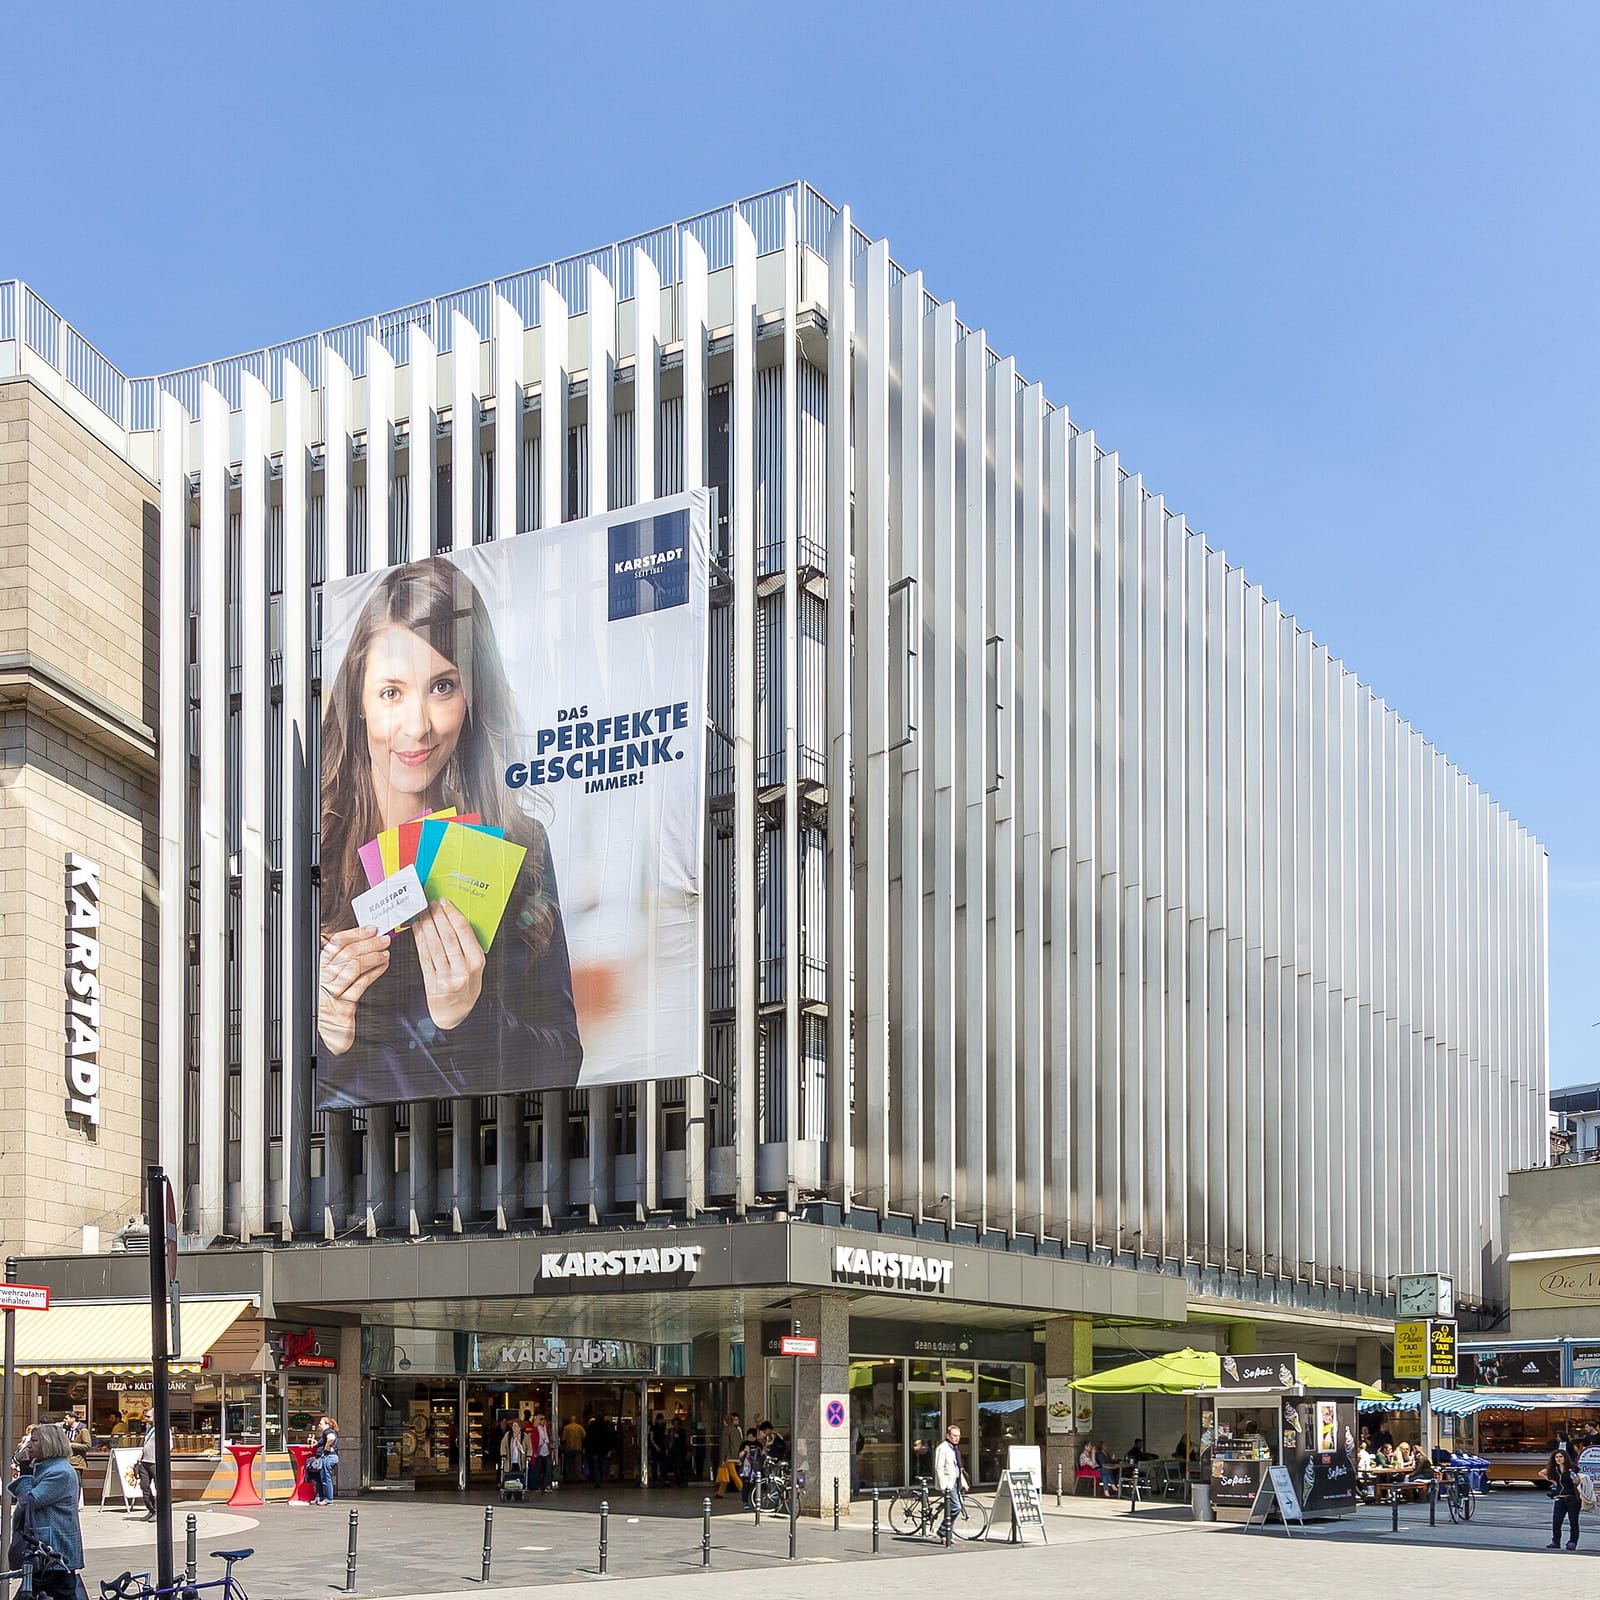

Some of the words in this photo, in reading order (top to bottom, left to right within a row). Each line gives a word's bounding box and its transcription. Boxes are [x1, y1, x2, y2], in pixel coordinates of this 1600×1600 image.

[614, 547, 683, 574] KARSTADT
[633, 568, 649, 579] SEIT
[557, 705, 588, 722] DAS
[537, 701, 688, 755] PERFEKTE
[505, 735, 684, 789] GESCHENK.
[585, 772, 644, 794] IMMER!
[369, 885, 407, 912] KARSTADT
[65, 851, 100, 1125] KARSTADT
[541, 1246, 702, 1278] KARSTADT
[835, 1246, 953, 1284] KARSTADT
[1548, 1275, 1575, 1288] Die
[502, 1347, 615, 1363] KARSTADT
[107, 1382, 127, 1391] PIZZA
